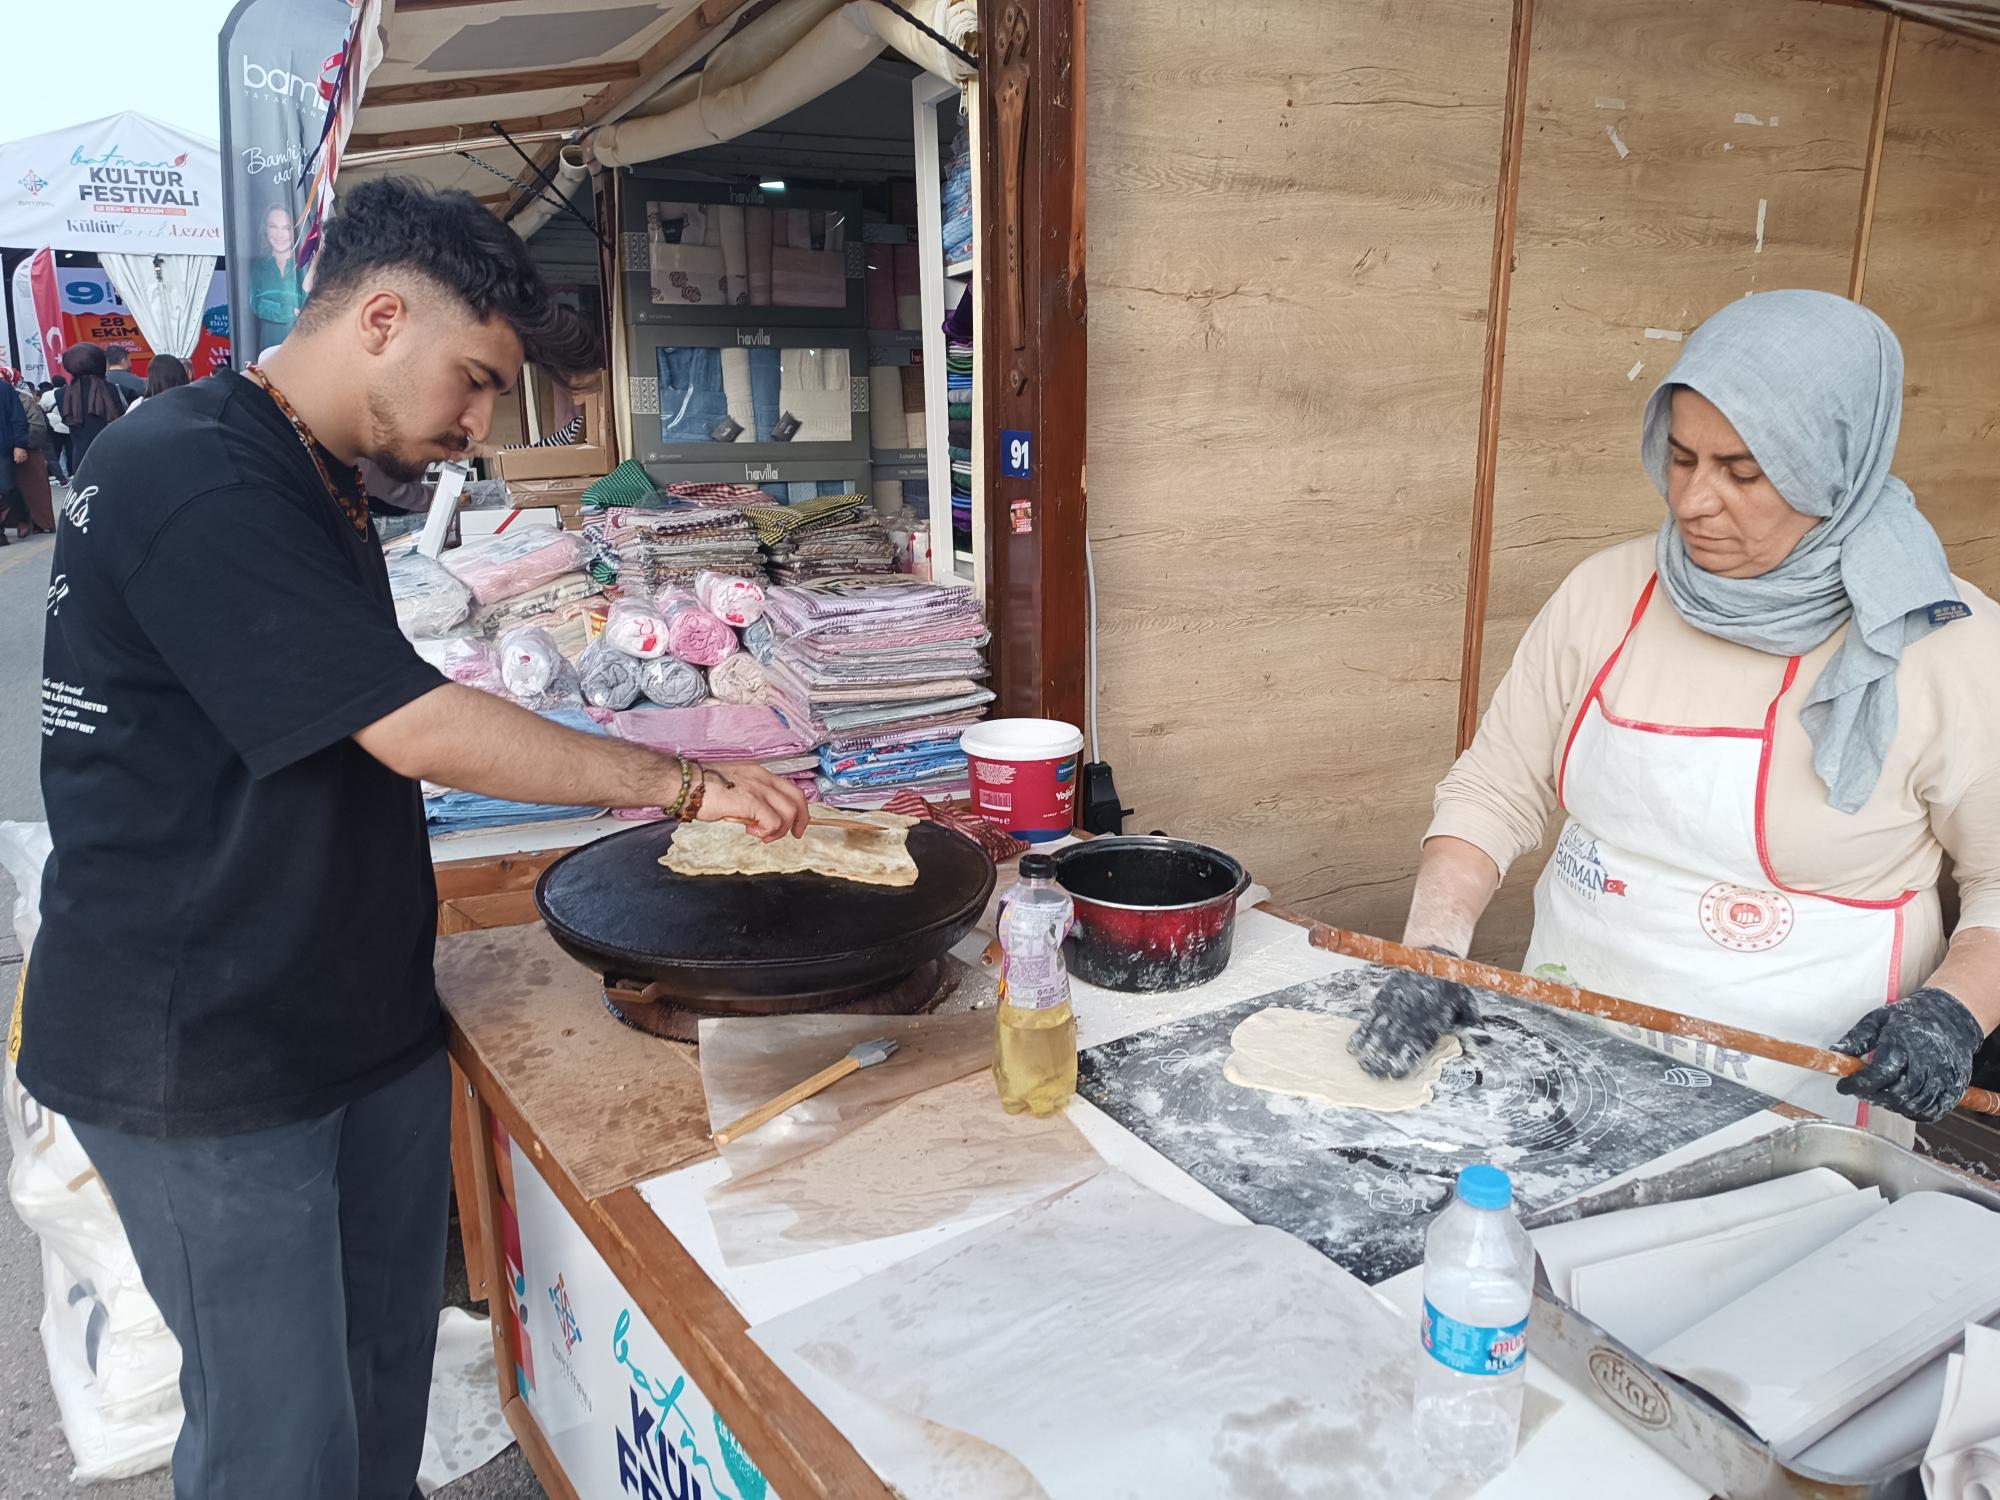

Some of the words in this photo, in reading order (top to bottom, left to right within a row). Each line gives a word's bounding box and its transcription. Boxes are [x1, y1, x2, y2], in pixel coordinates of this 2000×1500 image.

[70, 144, 177, 168] batman
[89, 167, 183, 188] KÜLTÜR
[79, 184, 200, 206] FESTİVALİ
[65, 281, 104, 305] 9
[100, 318, 125, 327] 28
[737, 328, 771, 345] havilla
[1011, 439, 1029, 470] 91
[745, 464, 779, 480] havilla
[1556, 842, 1605, 894] BATMAN
